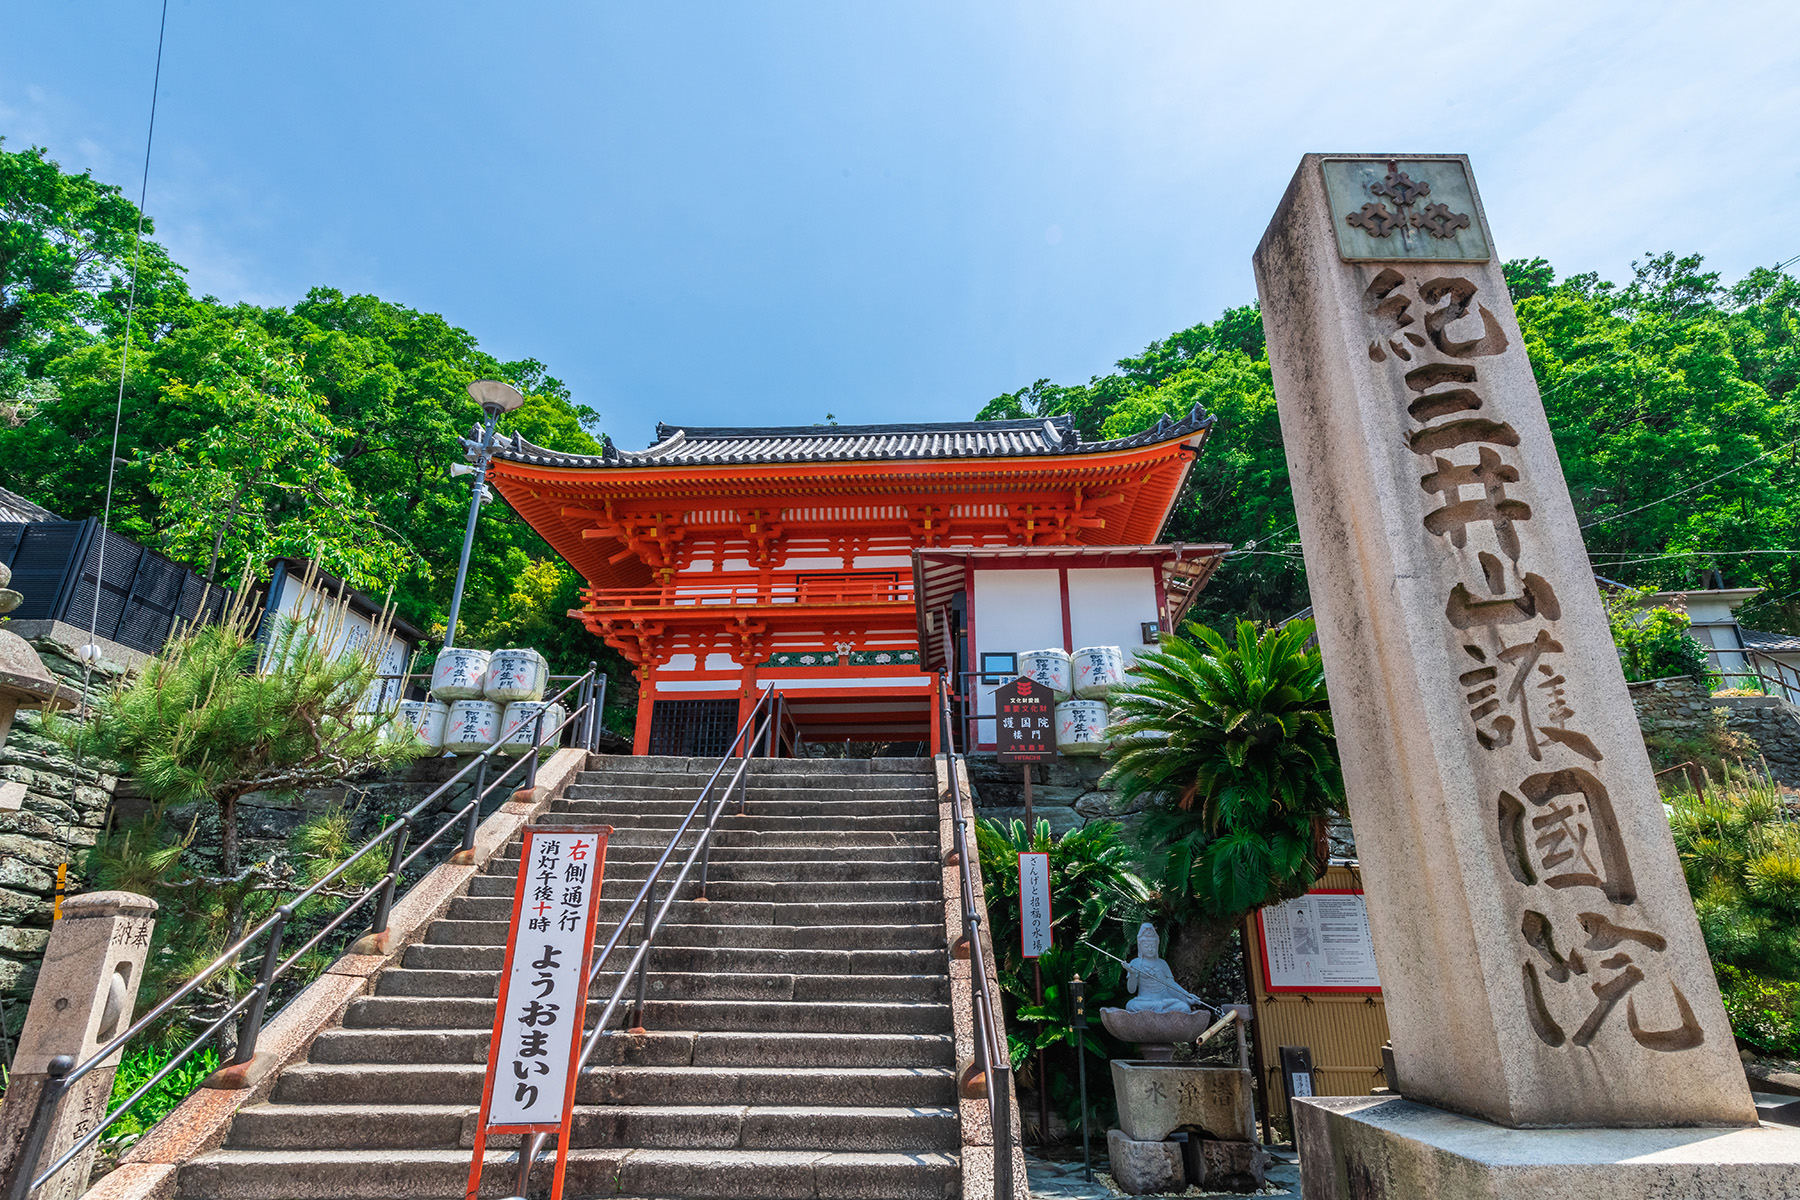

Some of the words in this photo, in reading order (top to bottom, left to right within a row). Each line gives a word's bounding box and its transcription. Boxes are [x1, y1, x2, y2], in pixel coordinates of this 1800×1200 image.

[1002, 716, 1050, 729] 護国院
[1003, 705, 1047, 713] 重要文化財
[528, 840, 561, 932] 消灯午後十時
[557, 839, 590, 932] 右側通行
[1029, 856, 1043, 952] ざんげと招福の水場
[512, 944, 563, 1111] ようおまいり
